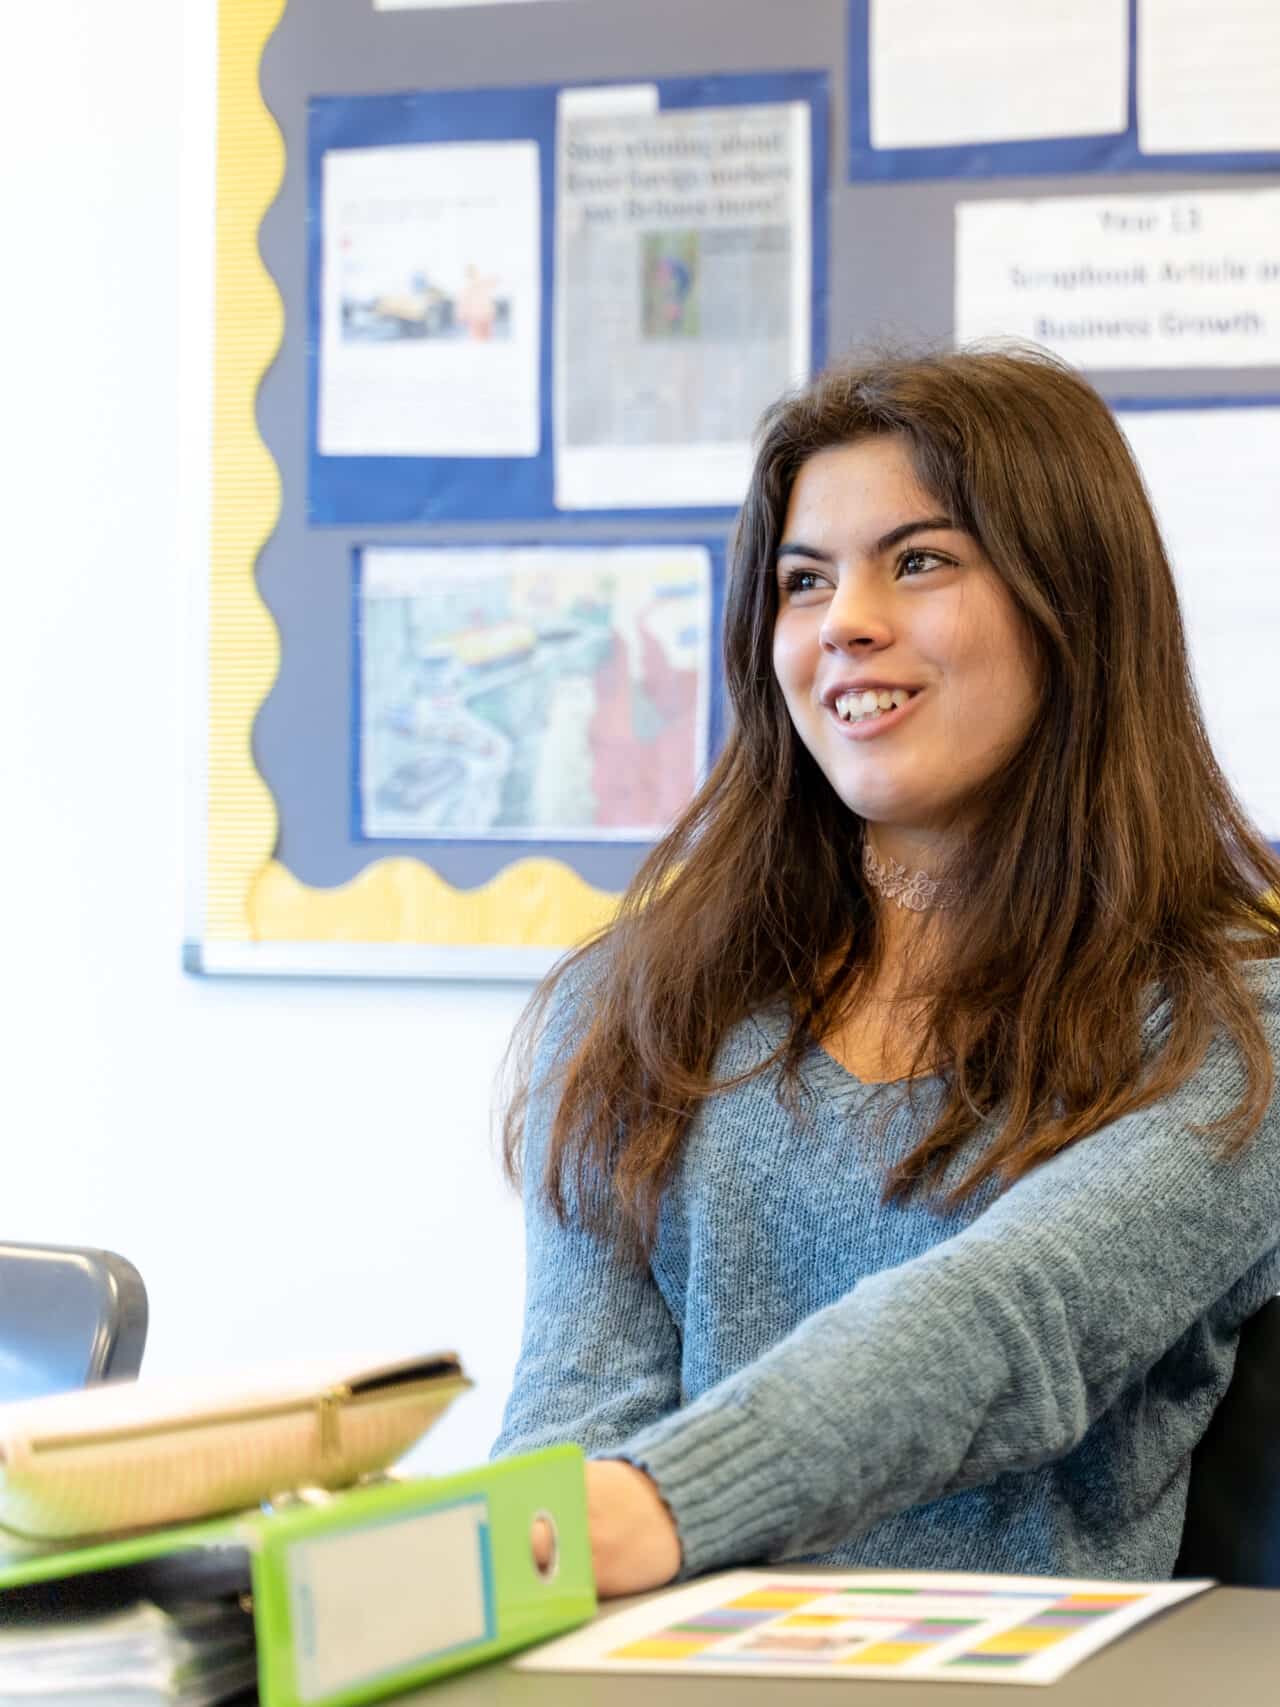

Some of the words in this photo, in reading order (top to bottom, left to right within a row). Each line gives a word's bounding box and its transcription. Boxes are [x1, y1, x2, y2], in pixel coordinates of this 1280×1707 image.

[1096, 208, 1160, 234] Year
[1008, 260, 1149, 293] Scrapbook
[1159, 255, 1248, 284] Article
[1033, 311, 1152, 342] Business
[1159, 308, 1266, 336] Growth
